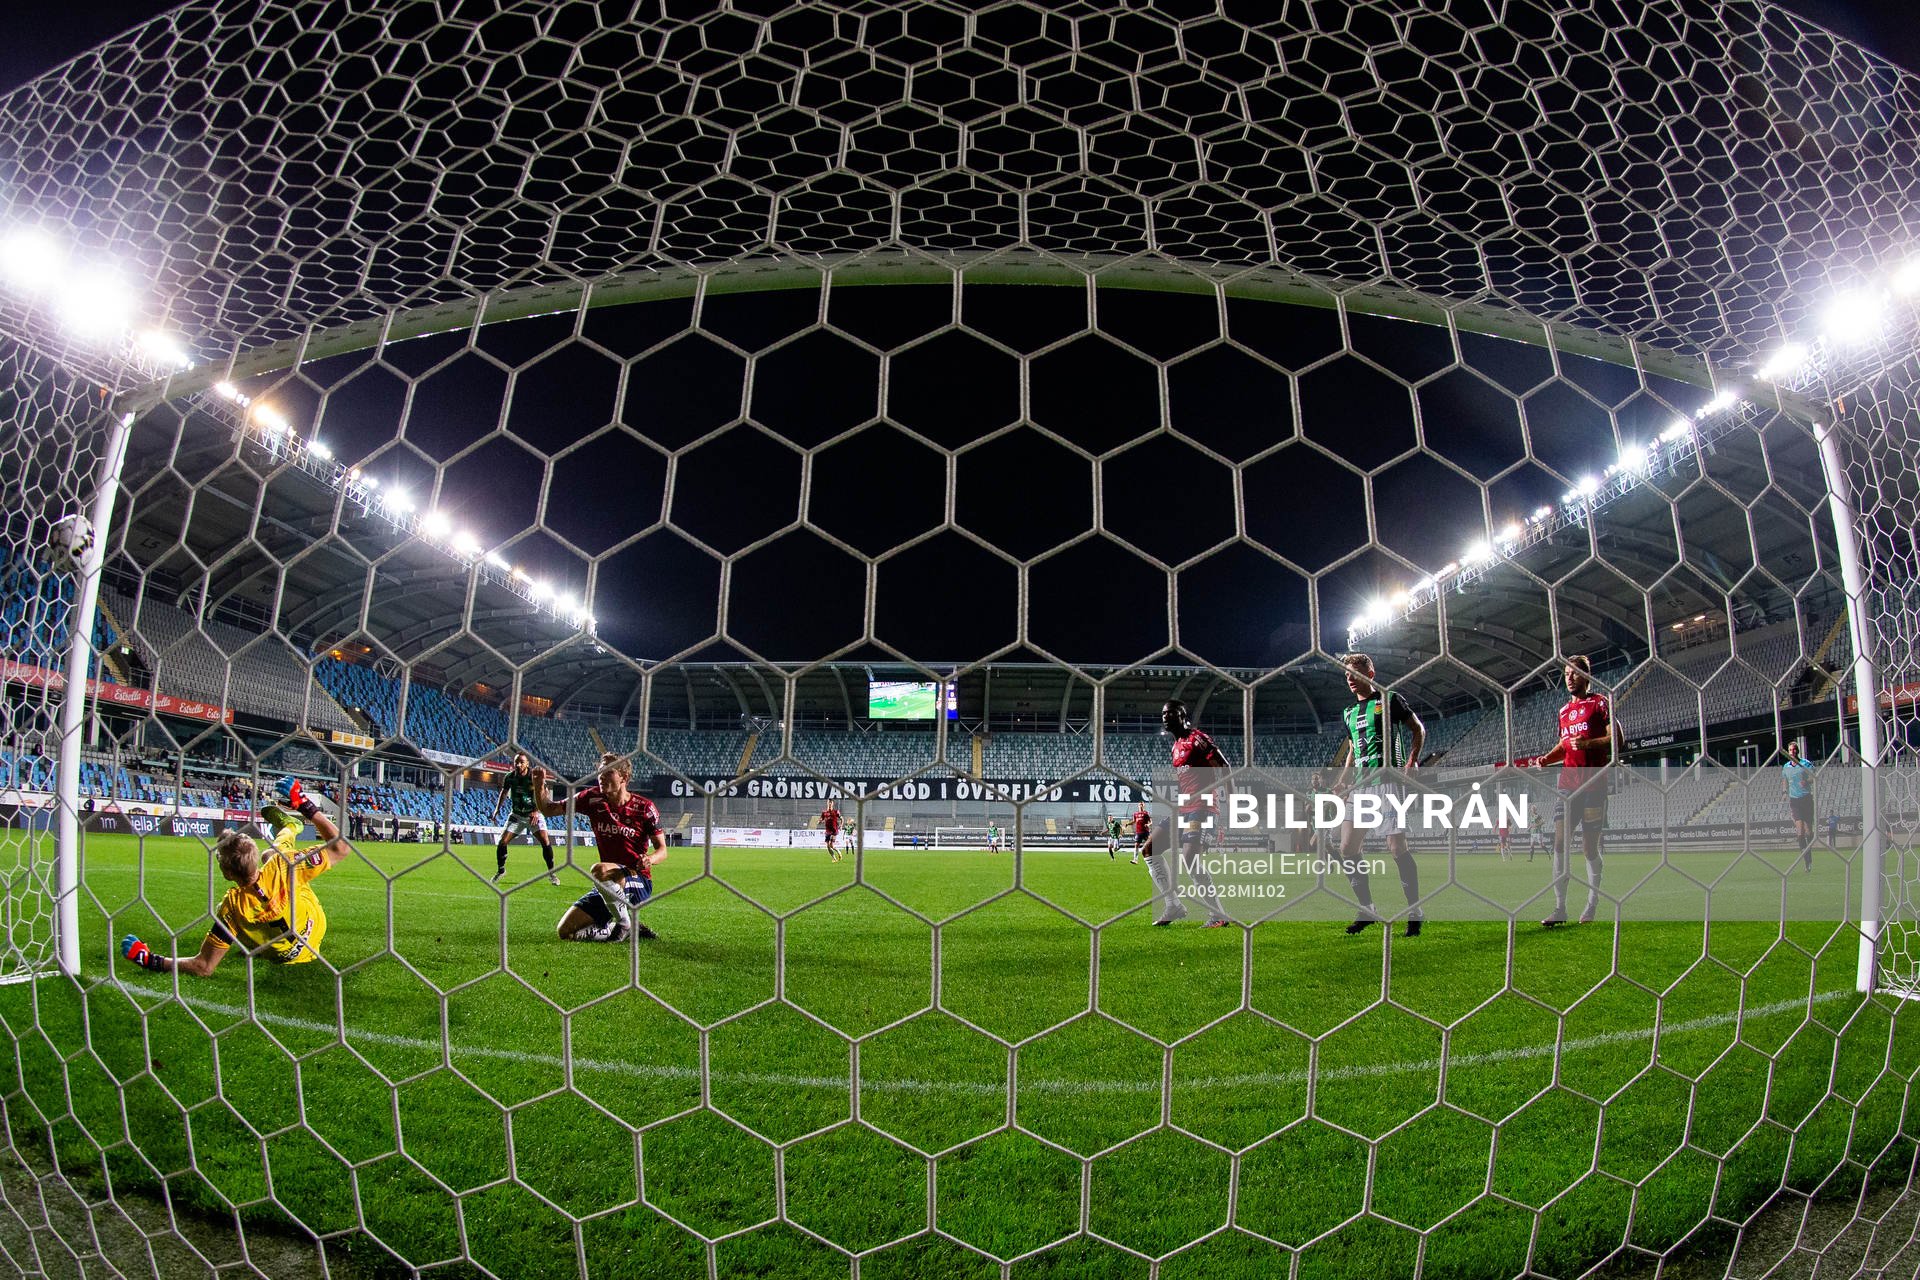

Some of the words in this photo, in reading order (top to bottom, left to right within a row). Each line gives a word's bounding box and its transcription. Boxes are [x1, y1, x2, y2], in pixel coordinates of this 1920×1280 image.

[114, 688, 141, 702] Estrella
[179, 702, 204, 714] Estrella
[704, 780, 738, 797] OSS
[747, 777, 867, 799] GRÖNSVART
[878, 778, 930, 799] GLÖD
[956, 778, 1063, 801] ÖVERFLÖD
[1089, 780, 1131, 802] KÖR
